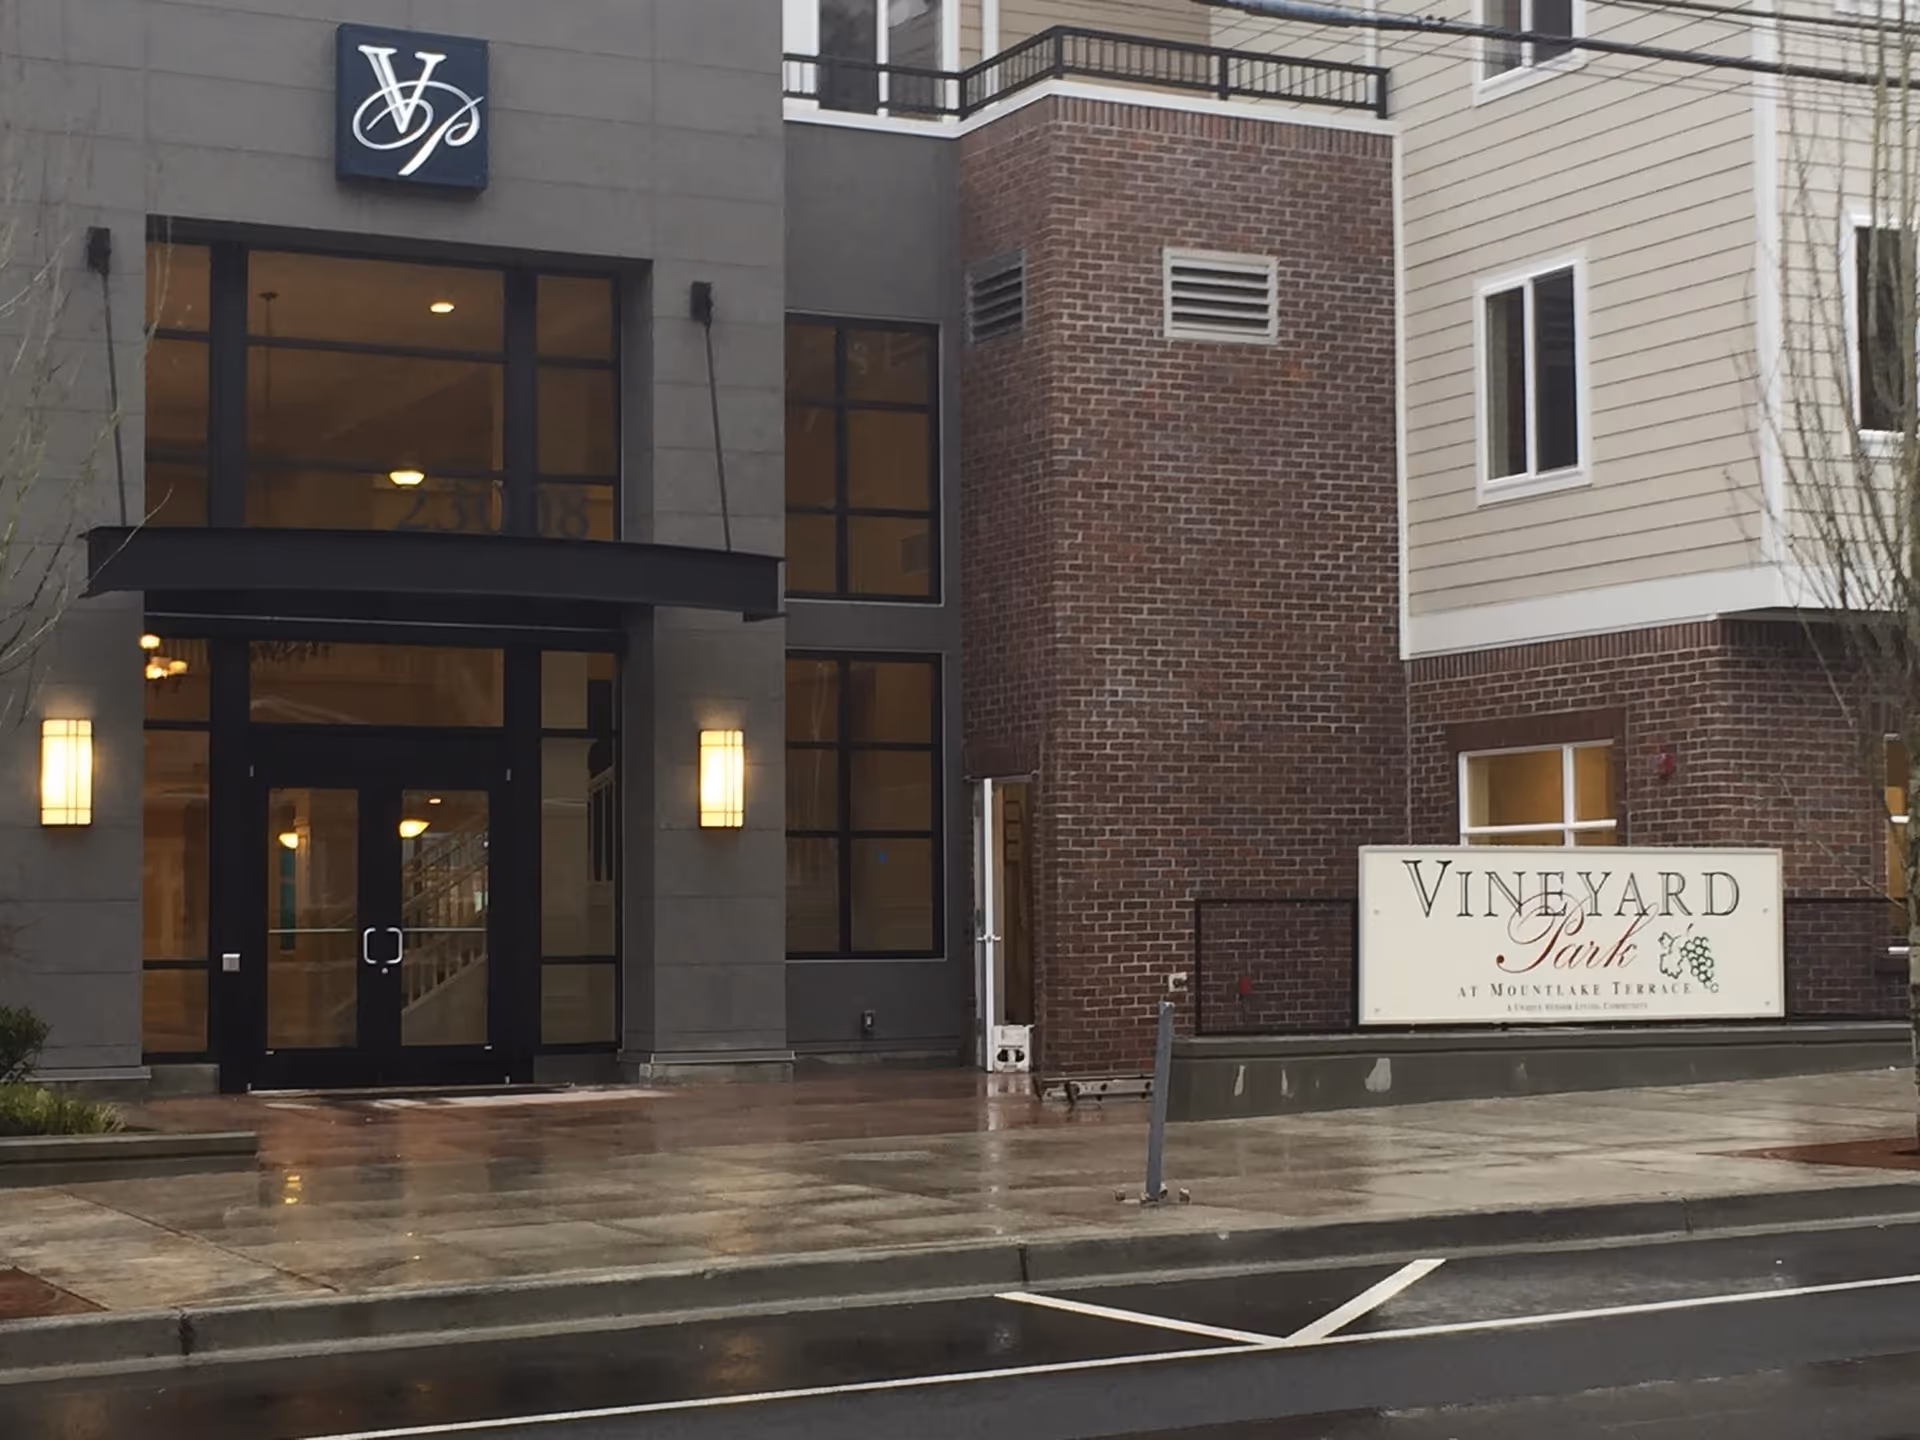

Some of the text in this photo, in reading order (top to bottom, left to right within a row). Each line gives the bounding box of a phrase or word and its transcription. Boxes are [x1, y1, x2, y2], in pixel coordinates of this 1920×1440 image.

[1402, 859, 1740, 918] VINEYARD
[1496, 891, 1658, 973] Park
[1490, 983, 1601, 997] MOUNTLAKE
[1612, 981, 1692, 995] TERRACE
